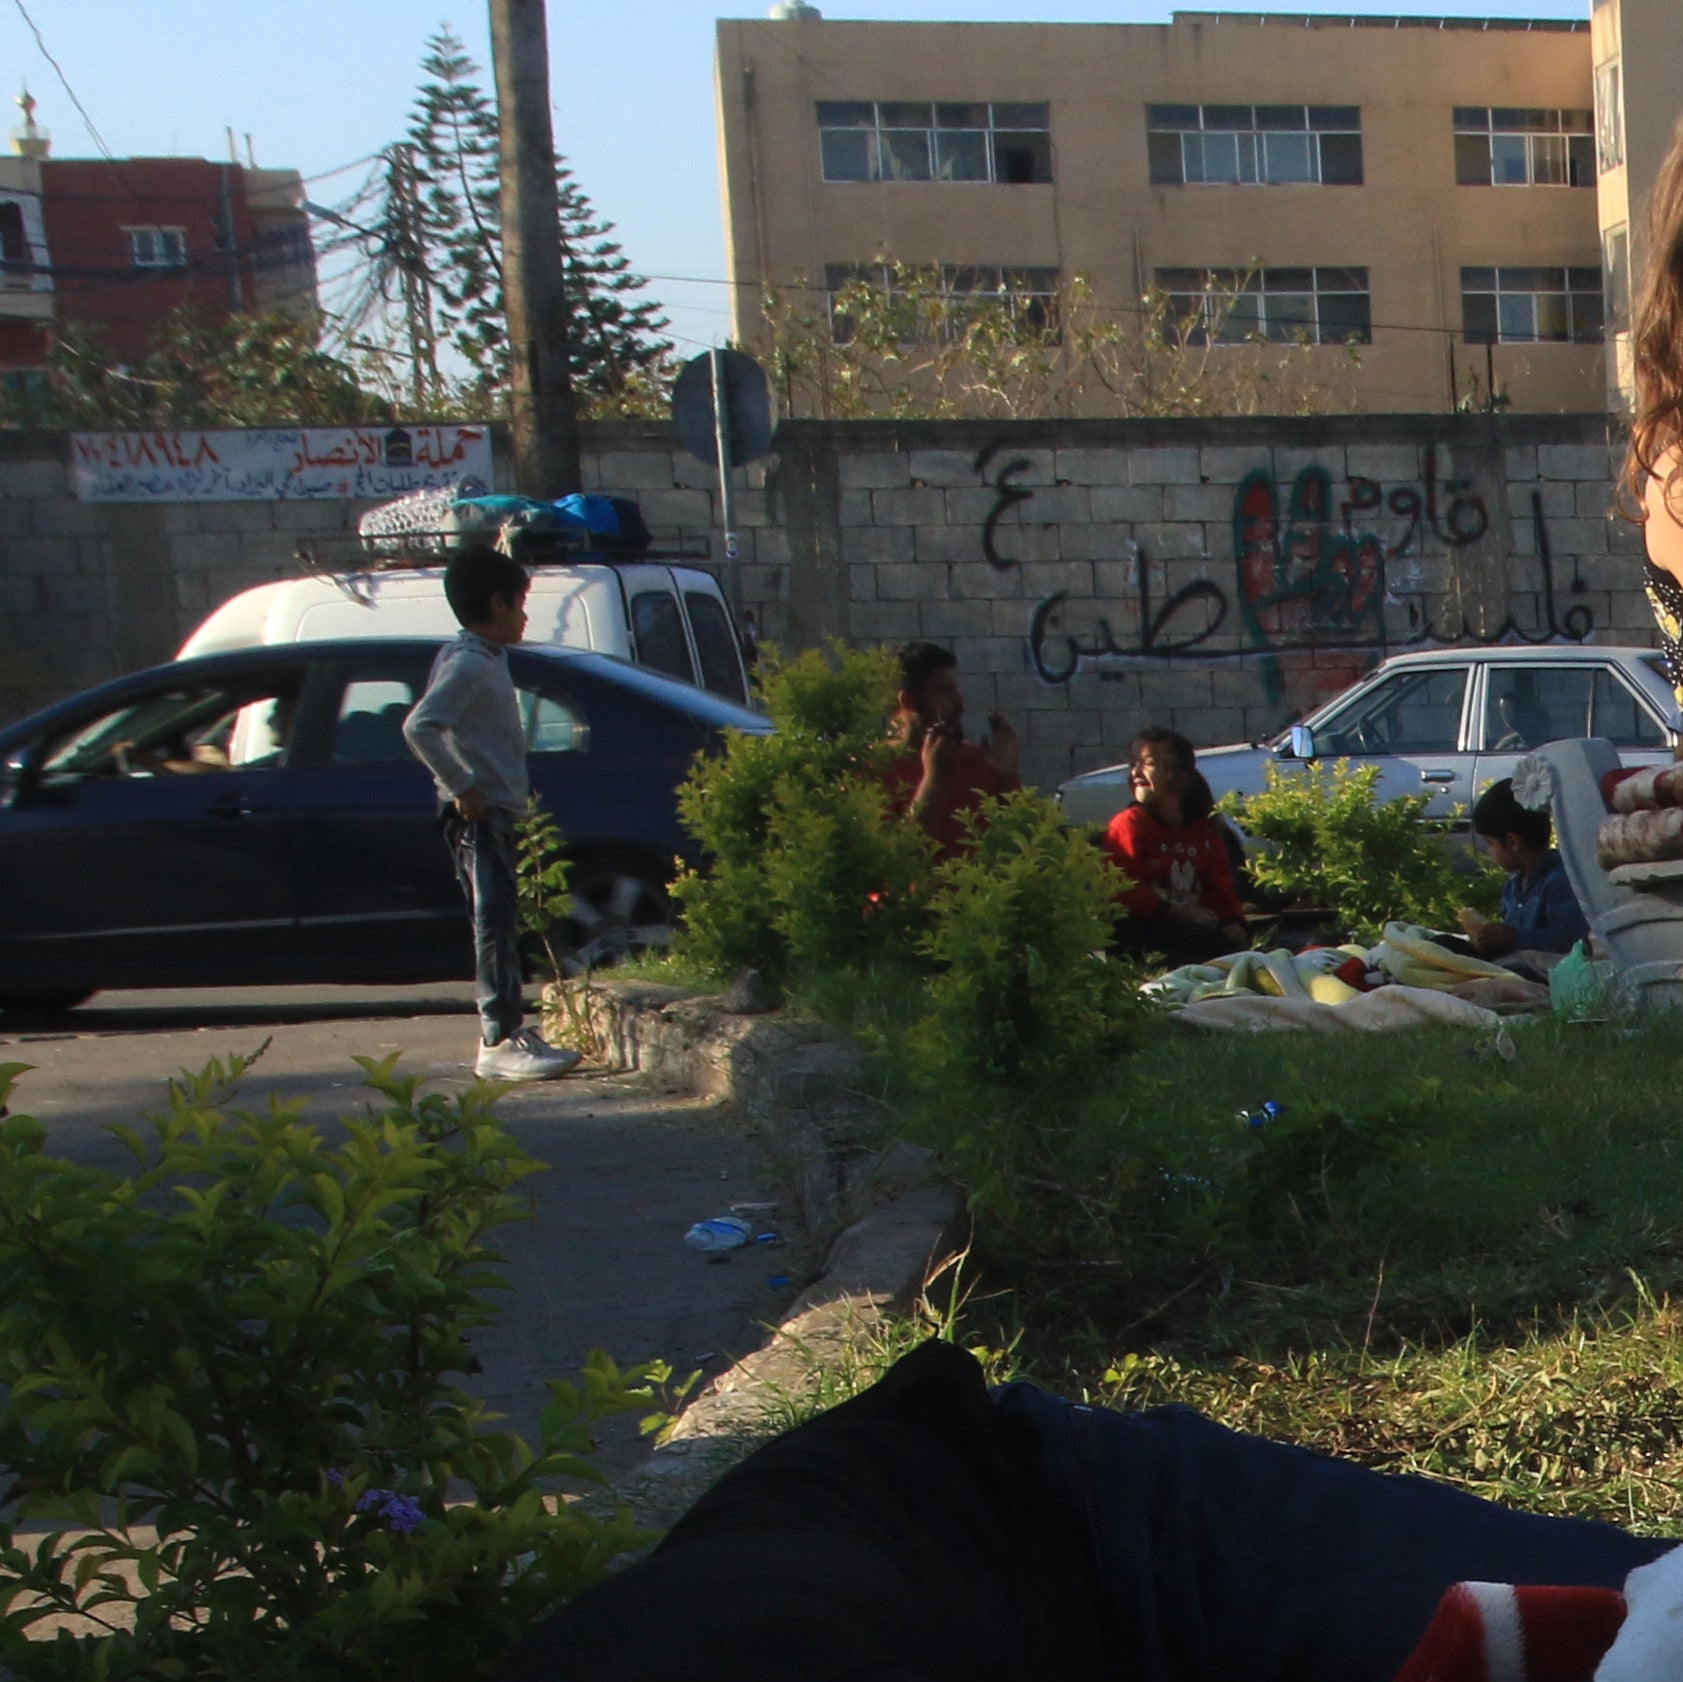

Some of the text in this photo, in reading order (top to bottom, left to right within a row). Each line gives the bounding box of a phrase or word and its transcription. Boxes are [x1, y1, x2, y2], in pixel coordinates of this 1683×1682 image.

[417, 428, 481, 468] حملة
[1341, 442, 1490, 560] قاوم
[1030, 492, 1594, 684] فلسطين
